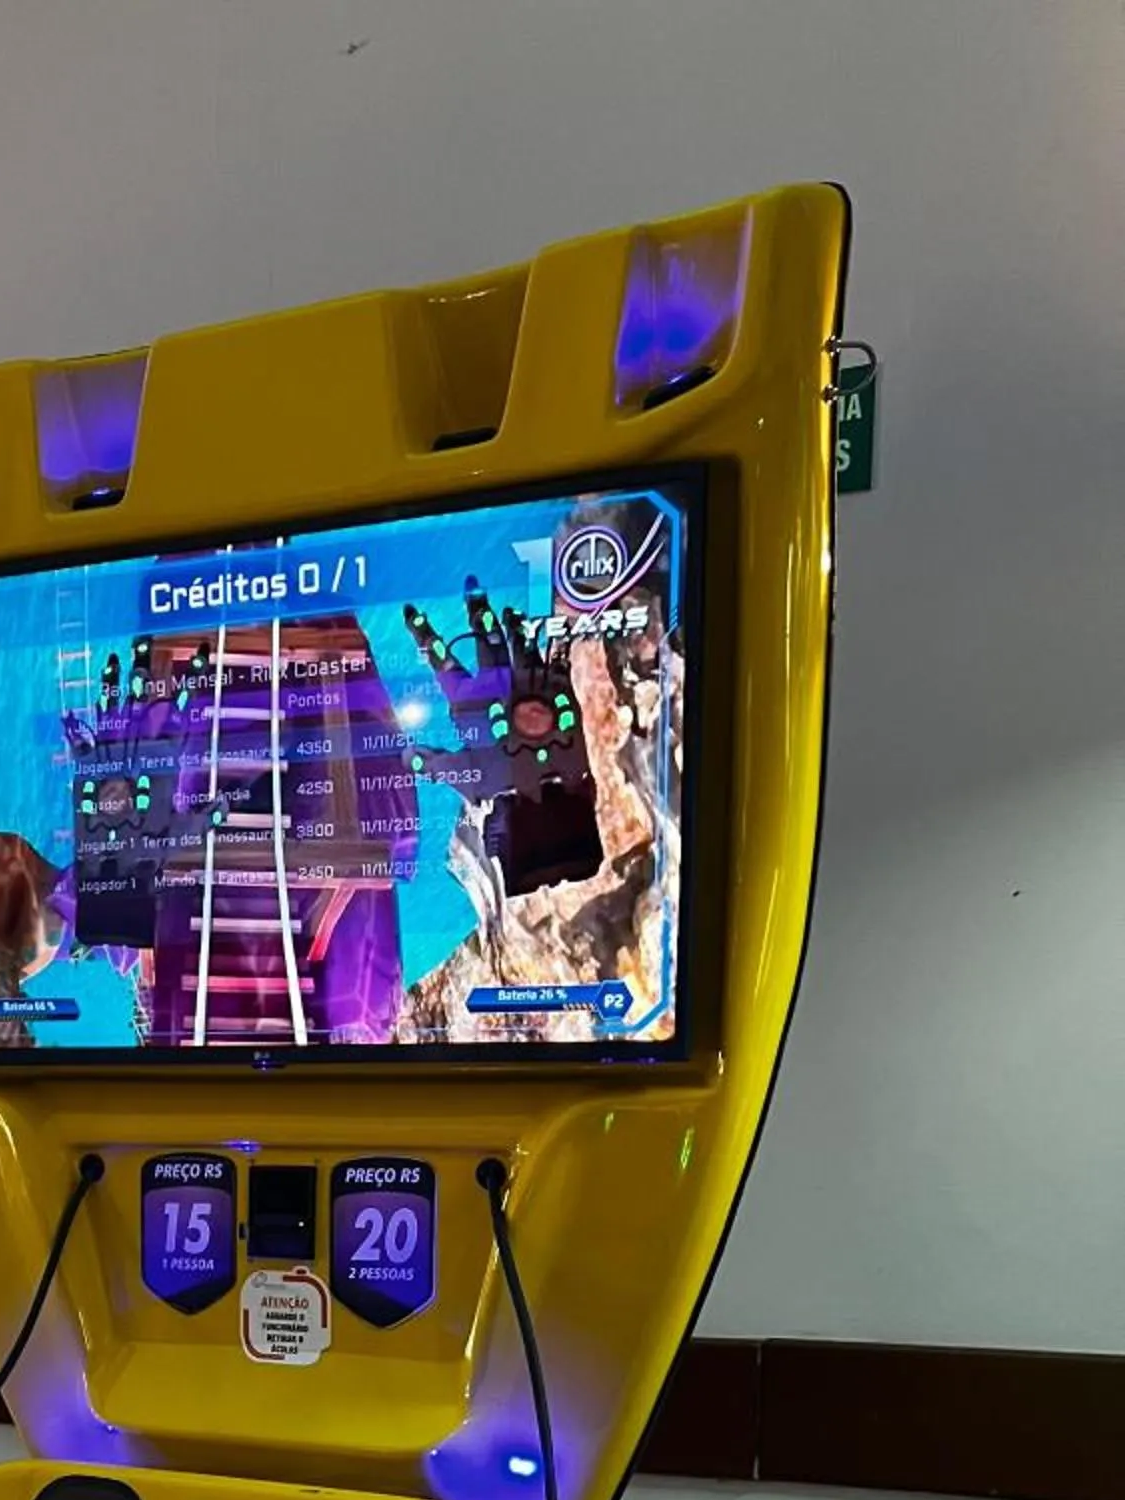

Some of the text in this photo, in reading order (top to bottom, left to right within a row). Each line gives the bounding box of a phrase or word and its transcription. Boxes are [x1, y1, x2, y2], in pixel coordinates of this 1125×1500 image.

[150, 573, 287, 614] Créditos
[298, 562, 320, 595] 0
[355, 555, 367, 587] 1
[521, 606, 649, 640] YEARS
[251, 663, 288, 683] Rilx
[294, 656, 370, 679] Coaster
[288, 690, 341, 709] Pontos
[296, 739, 332, 755] 4350
[296, 780, 334, 796] 4250
[436, 769, 482, 786] 20:33
[298, 865, 334, 881] 2450
[497, 989, 538, 1001] Bateria
[604, 993, 625, 1009] P2
[154, 1163, 201, 1182] PREÇO
[345, 1167, 395, 1188] PREÇO
[163, 1202, 212, 1255] 15
[350, 1206, 419, 1264] 20
[169, 1258, 215, 1272] PESSOA
[348, 1267, 415, 1282] 2 PESSOAS
